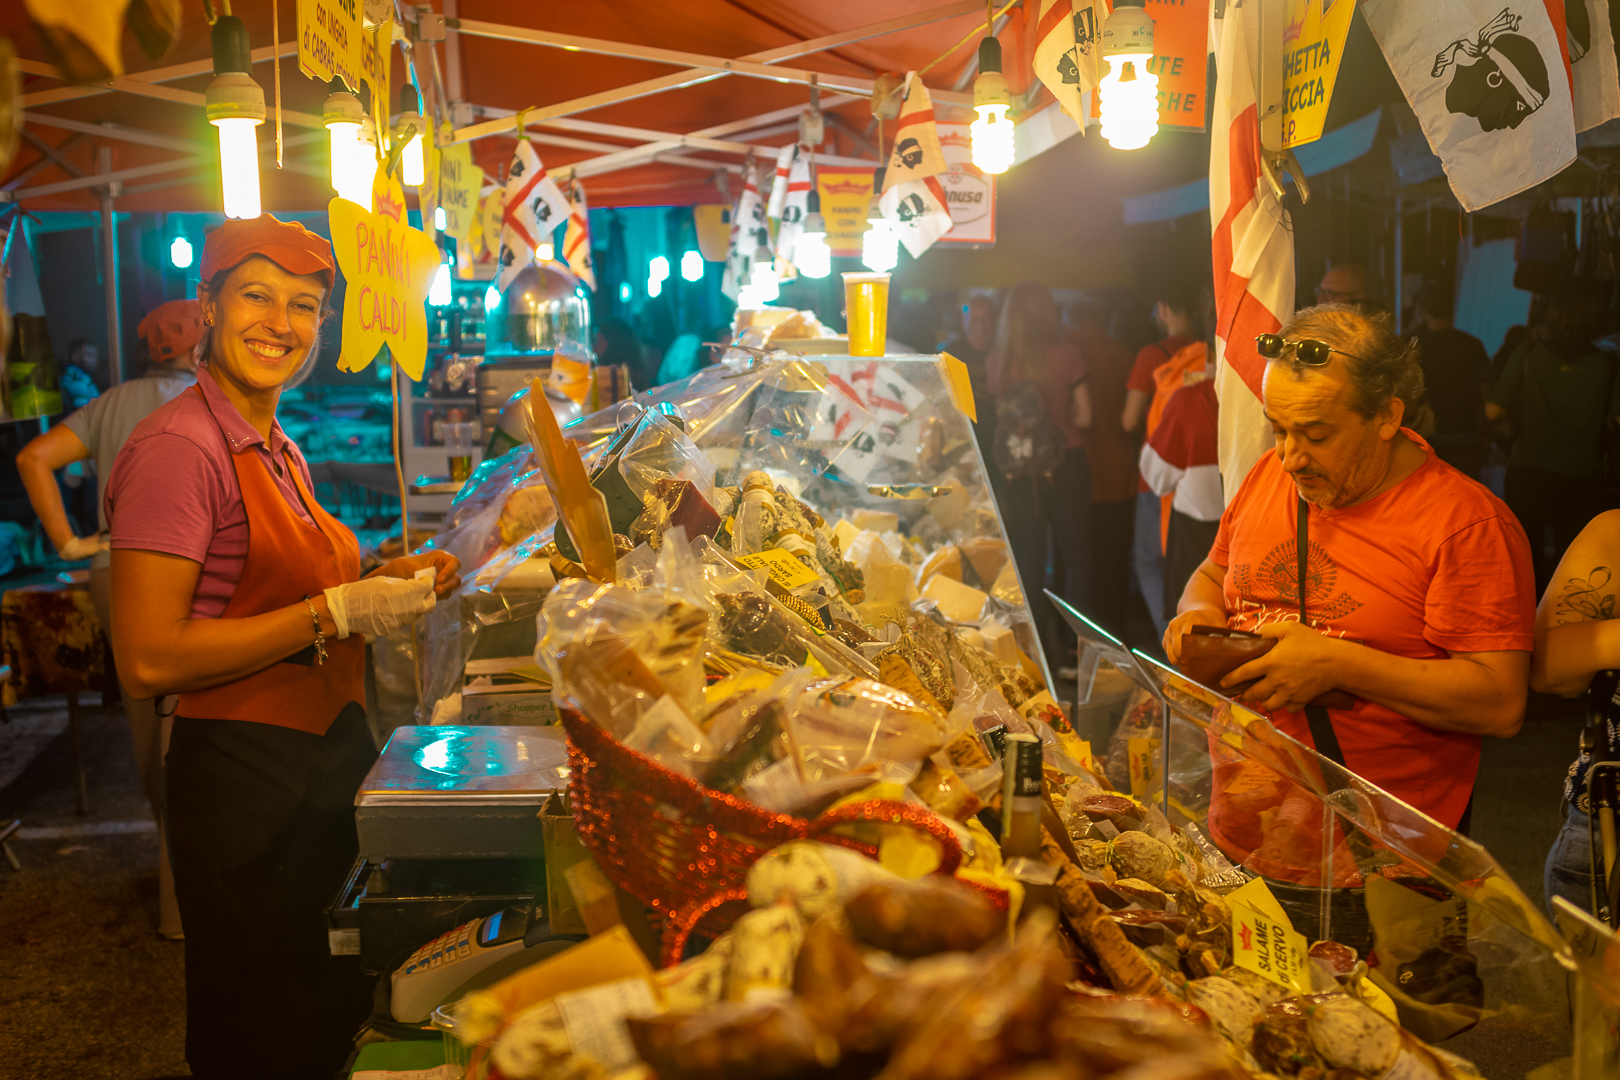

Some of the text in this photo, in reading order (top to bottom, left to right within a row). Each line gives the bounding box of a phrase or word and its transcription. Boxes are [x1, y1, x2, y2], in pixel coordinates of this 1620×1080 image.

[316, 2, 327, 30] con
[303, 23, 310, 52] di
[312, 32, 335, 76] CABRAS
[1282, 37, 1331, 79] HETTA
[832, 206, 862, 215] PANINI
[837, 219, 857, 227] CON
[356, 221, 411, 287] PANINI
[359, 284, 407, 341] CALDI
[769, 560, 793, 578] SARDO
[506, 703, 547, 714] Shopper
[1254, 918, 1271, 972] SALAME
[1272, 925, 1290, 984] di CERVO
